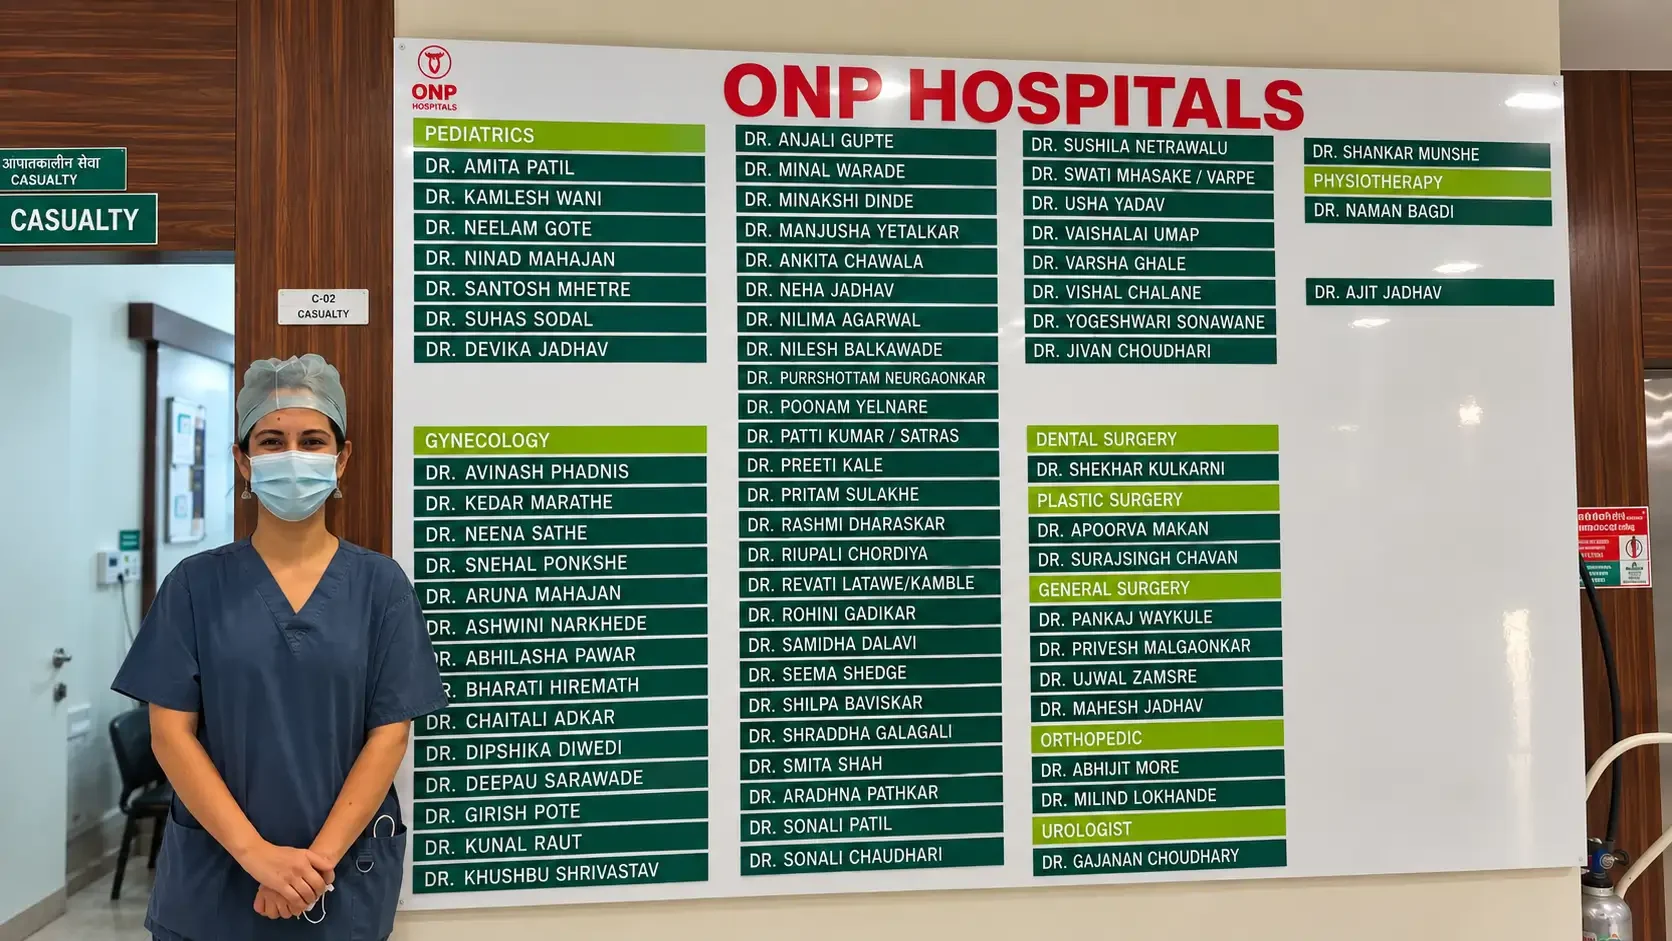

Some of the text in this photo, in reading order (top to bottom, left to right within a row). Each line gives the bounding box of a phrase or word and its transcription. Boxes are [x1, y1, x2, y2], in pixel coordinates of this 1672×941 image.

[411, 83, 458, 101] ONP
[723, 62, 1305, 131] ONP HOSPITALS
[411, 102, 458, 111] HOSPITALS
[425, 125, 535, 144] PEDIATRICS
[744, 131, 894, 149] DR. ANJALI GUPTE
[1031, 136, 1228, 155] DR. SUSHILA NETRAWALU
[1313, 143, 1480, 162] DR. SHANKAR MUNSHE
[425, 157, 575, 176] DR. AMITA PATIL
[1032, 165, 1256, 185] DR. SWATI MHASAKE / VARPE
[11, 174, 78, 186] CASUALTY
[1313, 173, 1443, 190] PHYSIOTHERAPY
[425, 188, 602, 207] DR. KAMLESH WANI
[745, 191, 914, 209] DR. MINAKSHI DINDE
[1314, 202, 1454, 219] DR. NAMAN BAGDI
[10, 208, 140, 232] CASUALTY
[1032, 225, 1200, 242] DR. VAISHALAI UMAP
[426, 249, 615, 267] DR. NINAD MAHAJAN
[745, 252, 924, 269] DR. ANKITA CHAWALA
[426, 280, 631, 297] DR. SANTOSH MHETRE
[1033, 284, 1202, 300] DR. VISHAL CHALANE
[1315, 284, 1442, 300] DR. AJIT JADHAV
[311, 293, 336, 304] C-02
[297, 309, 350, 319] CASUALTY
[746, 311, 921, 328] DR. NILIMA AGARWAL
[1033, 313, 1265, 330] DR. YOGESHWARI SONAWANE
[426, 341, 609, 357] DR. DEVIKA JADHAV
[747, 370, 986, 385] DR. PURRSHOTTAM NEURGAONKAR
[747, 399, 928, 414] DR. POONAM YELNARE
[425, 432, 550, 449] GYNECOLOGY
[1036, 431, 1177, 447] DENTAL SURGERY
[426, 463, 629, 481] DR. AVINASH PHADNIS
[747, 457, 883, 473] DR. PREETI KALE
[1036, 461, 1225, 477] DR. SHEKHAR KULKARNI
[426, 494, 613, 511] DR. KEDAR MARATHE
[747, 486, 920, 503] DR. PRITAM SULAKHE
[1037, 491, 1183, 508] PLASTIC SURGERY
[1037, 520, 1209, 538] DR. APOORVA MAKAN
[748, 546, 928, 563] DR. RIUPALI CHORDIYA
[426, 554, 628, 574] DR. SNEHAL PONKSHE
[1038, 580, 1191, 598] GENERAL SURGERY
[748, 605, 916, 623] DR. ROHINI GADIKAR
[1039, 609, 1213, 627] DR. PANKAJ WAYKULE
[426, 615, 647, 636] DR. ASHWINI NARKHEDE
[748, 664, 907, 683] DR. SEEMA SHEDGE
[1039, 668, 1197, 688] DR. UJWAL ZAMSRE
[426, 709, 615, 730] DR. CHAITALI ADKAR
[749, 723, 952, 744] DR. SHRADDHA GALAGALI
[1040, 730, 1143, 748] ORTHOPEDIC
[1041, 759, 1180, 778] DR. ABHIJIT MORE
[426, 769, 644, 794] DR. DEEPAU SARAWADE
[749, 784, 939, 805] DR. ARADHNA PATHKAR
[425, 802, 581, 825] DR. GIRISH POTE
[749, 815, 893, 836] DR. SONALI PATIL
[1042, 820, 1133, 839] UROLOGIST
[749, 846, 942, 869] DR. SONALI CHAUDHARI
[1042, 848, 1240, 870] DR. GAJANAN CHOUDHARY
[424, 861, 659, 887] DR. KHUSHBU SHRIVASTAV
